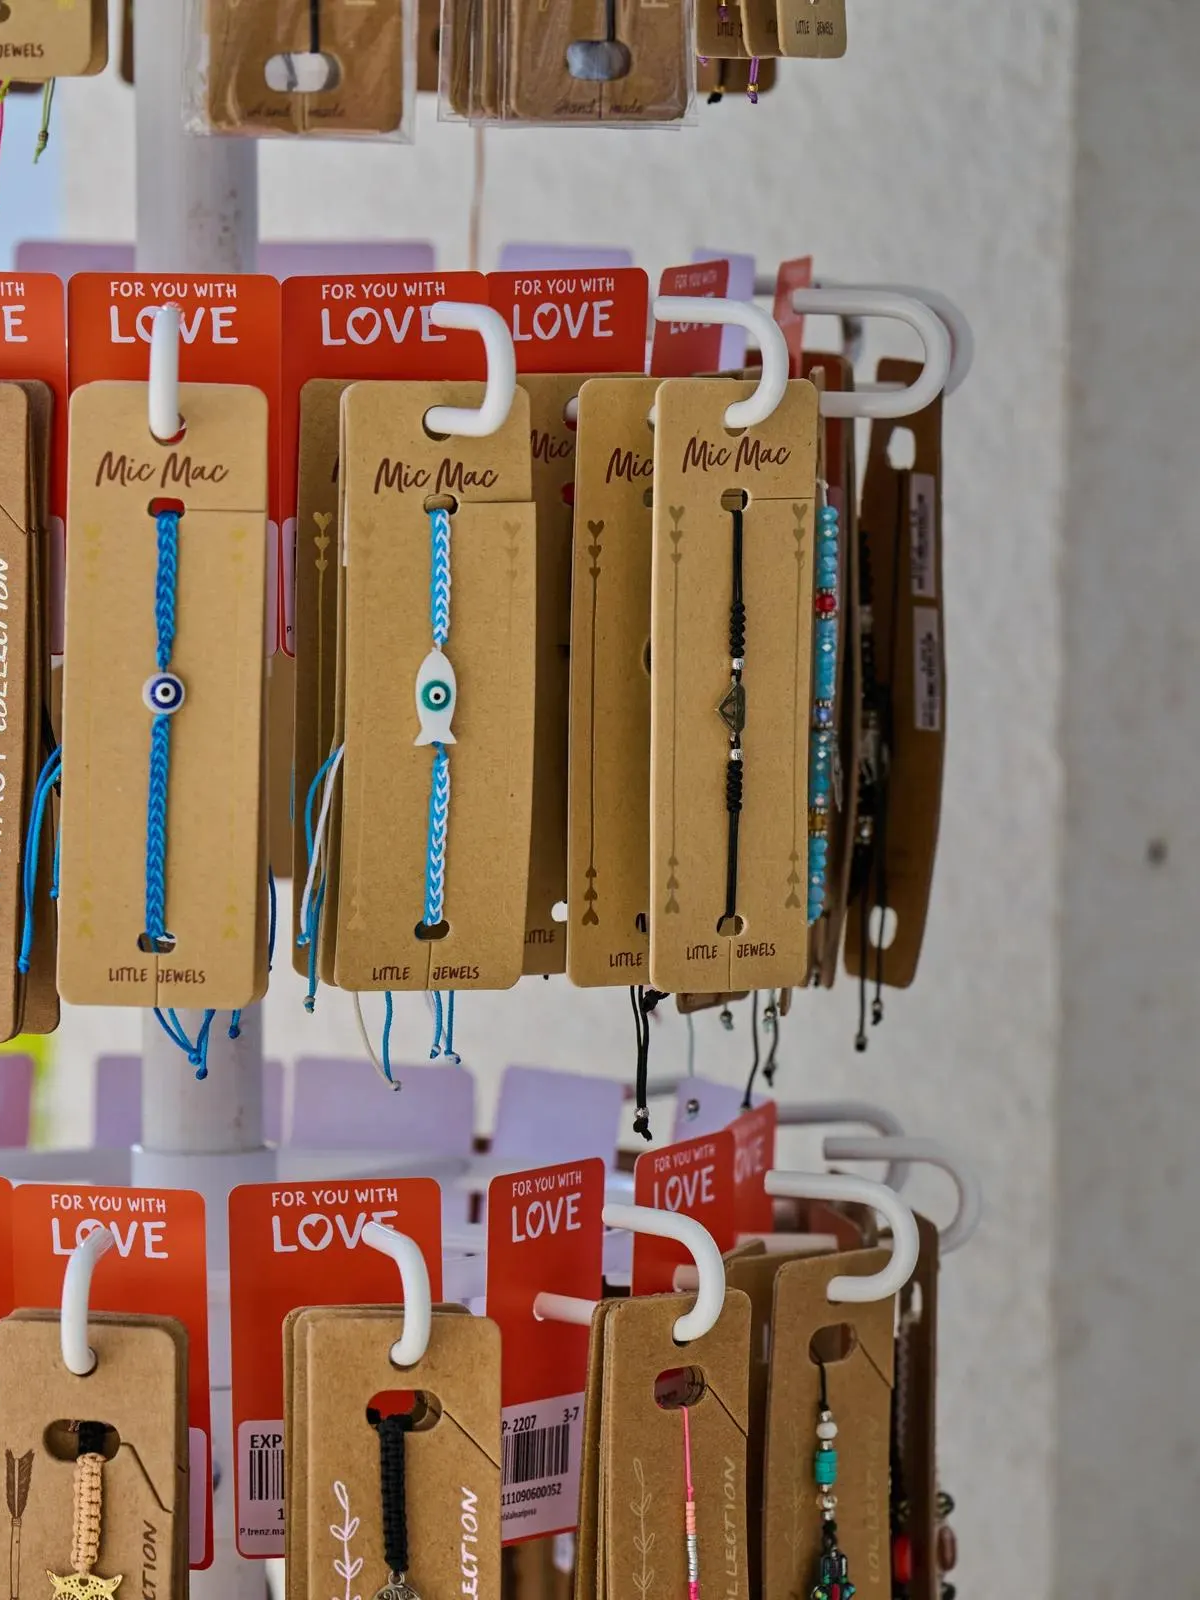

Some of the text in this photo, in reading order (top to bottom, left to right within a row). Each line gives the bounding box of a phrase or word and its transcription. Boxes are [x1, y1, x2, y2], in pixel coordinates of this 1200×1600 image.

[110, 281, 237, 298] FOR YOU WITH
[321, 281, 446, 300] FOR YOU WITH
[514, 277, 615, 295] FOR YOU WITH
[321, 306, 447, 346] LOVE
[513, 300, 614, 341] LOVE
[606, 447, 654, 484] Mic
[682, 436, 791, 473] Mic Mac
[95, 451, 229, 488] Mic Mac
[374, 457, 498, 494] Mic Mac
[609, 952, 643, 968] LITTLE
[686, 943, 777, 961] LITTLE JEWELS
[109, 966, 206, 984] LITTLE JEWELS
[372, 966, 480, 981] LITTLE JEWELS
[654, 1156, 671, 1174] FOR
[673, 1149, 692, 1168] YOU
[512, 1170, 582, 1198] FOR YOU WITH
[51, 1194, 166, 1213] FOR YOU WITH
[272, 1187, 398, 1208] FOR YOU WITH
[511, 1192, 582, 1243] LOVE
[513, 1415, 537, 1433] 2207
[563, 1406, 580, 1423] 3-7
